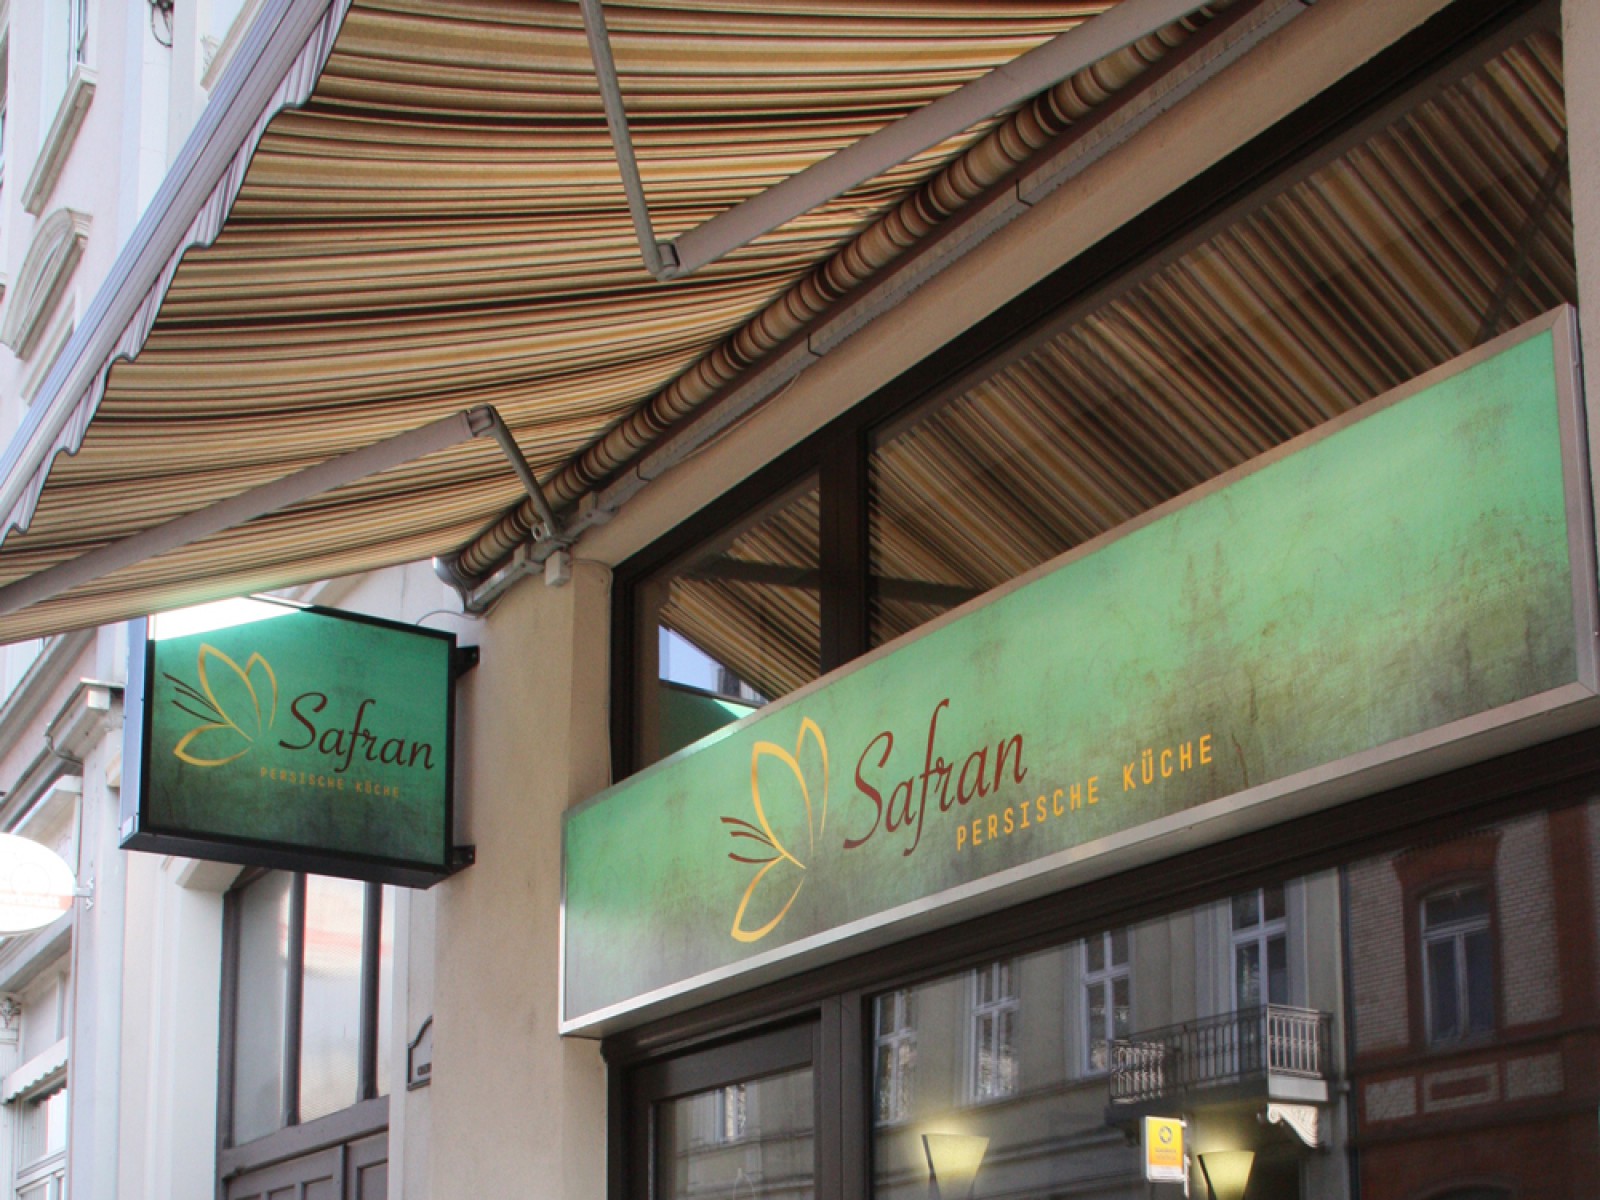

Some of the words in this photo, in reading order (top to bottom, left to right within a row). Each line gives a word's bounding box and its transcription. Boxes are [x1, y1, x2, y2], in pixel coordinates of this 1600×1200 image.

[260, 766, 345, 791] PERSISCHE
[355, 773, 400, 799] KÜCHE
[278, 691, 434, 774] Safran
[842, 697, 1029, 858] Safran
[956, 775, 1099, 851] PERSISCHE
[1122, 733, 1213, 792] KÜCHE
